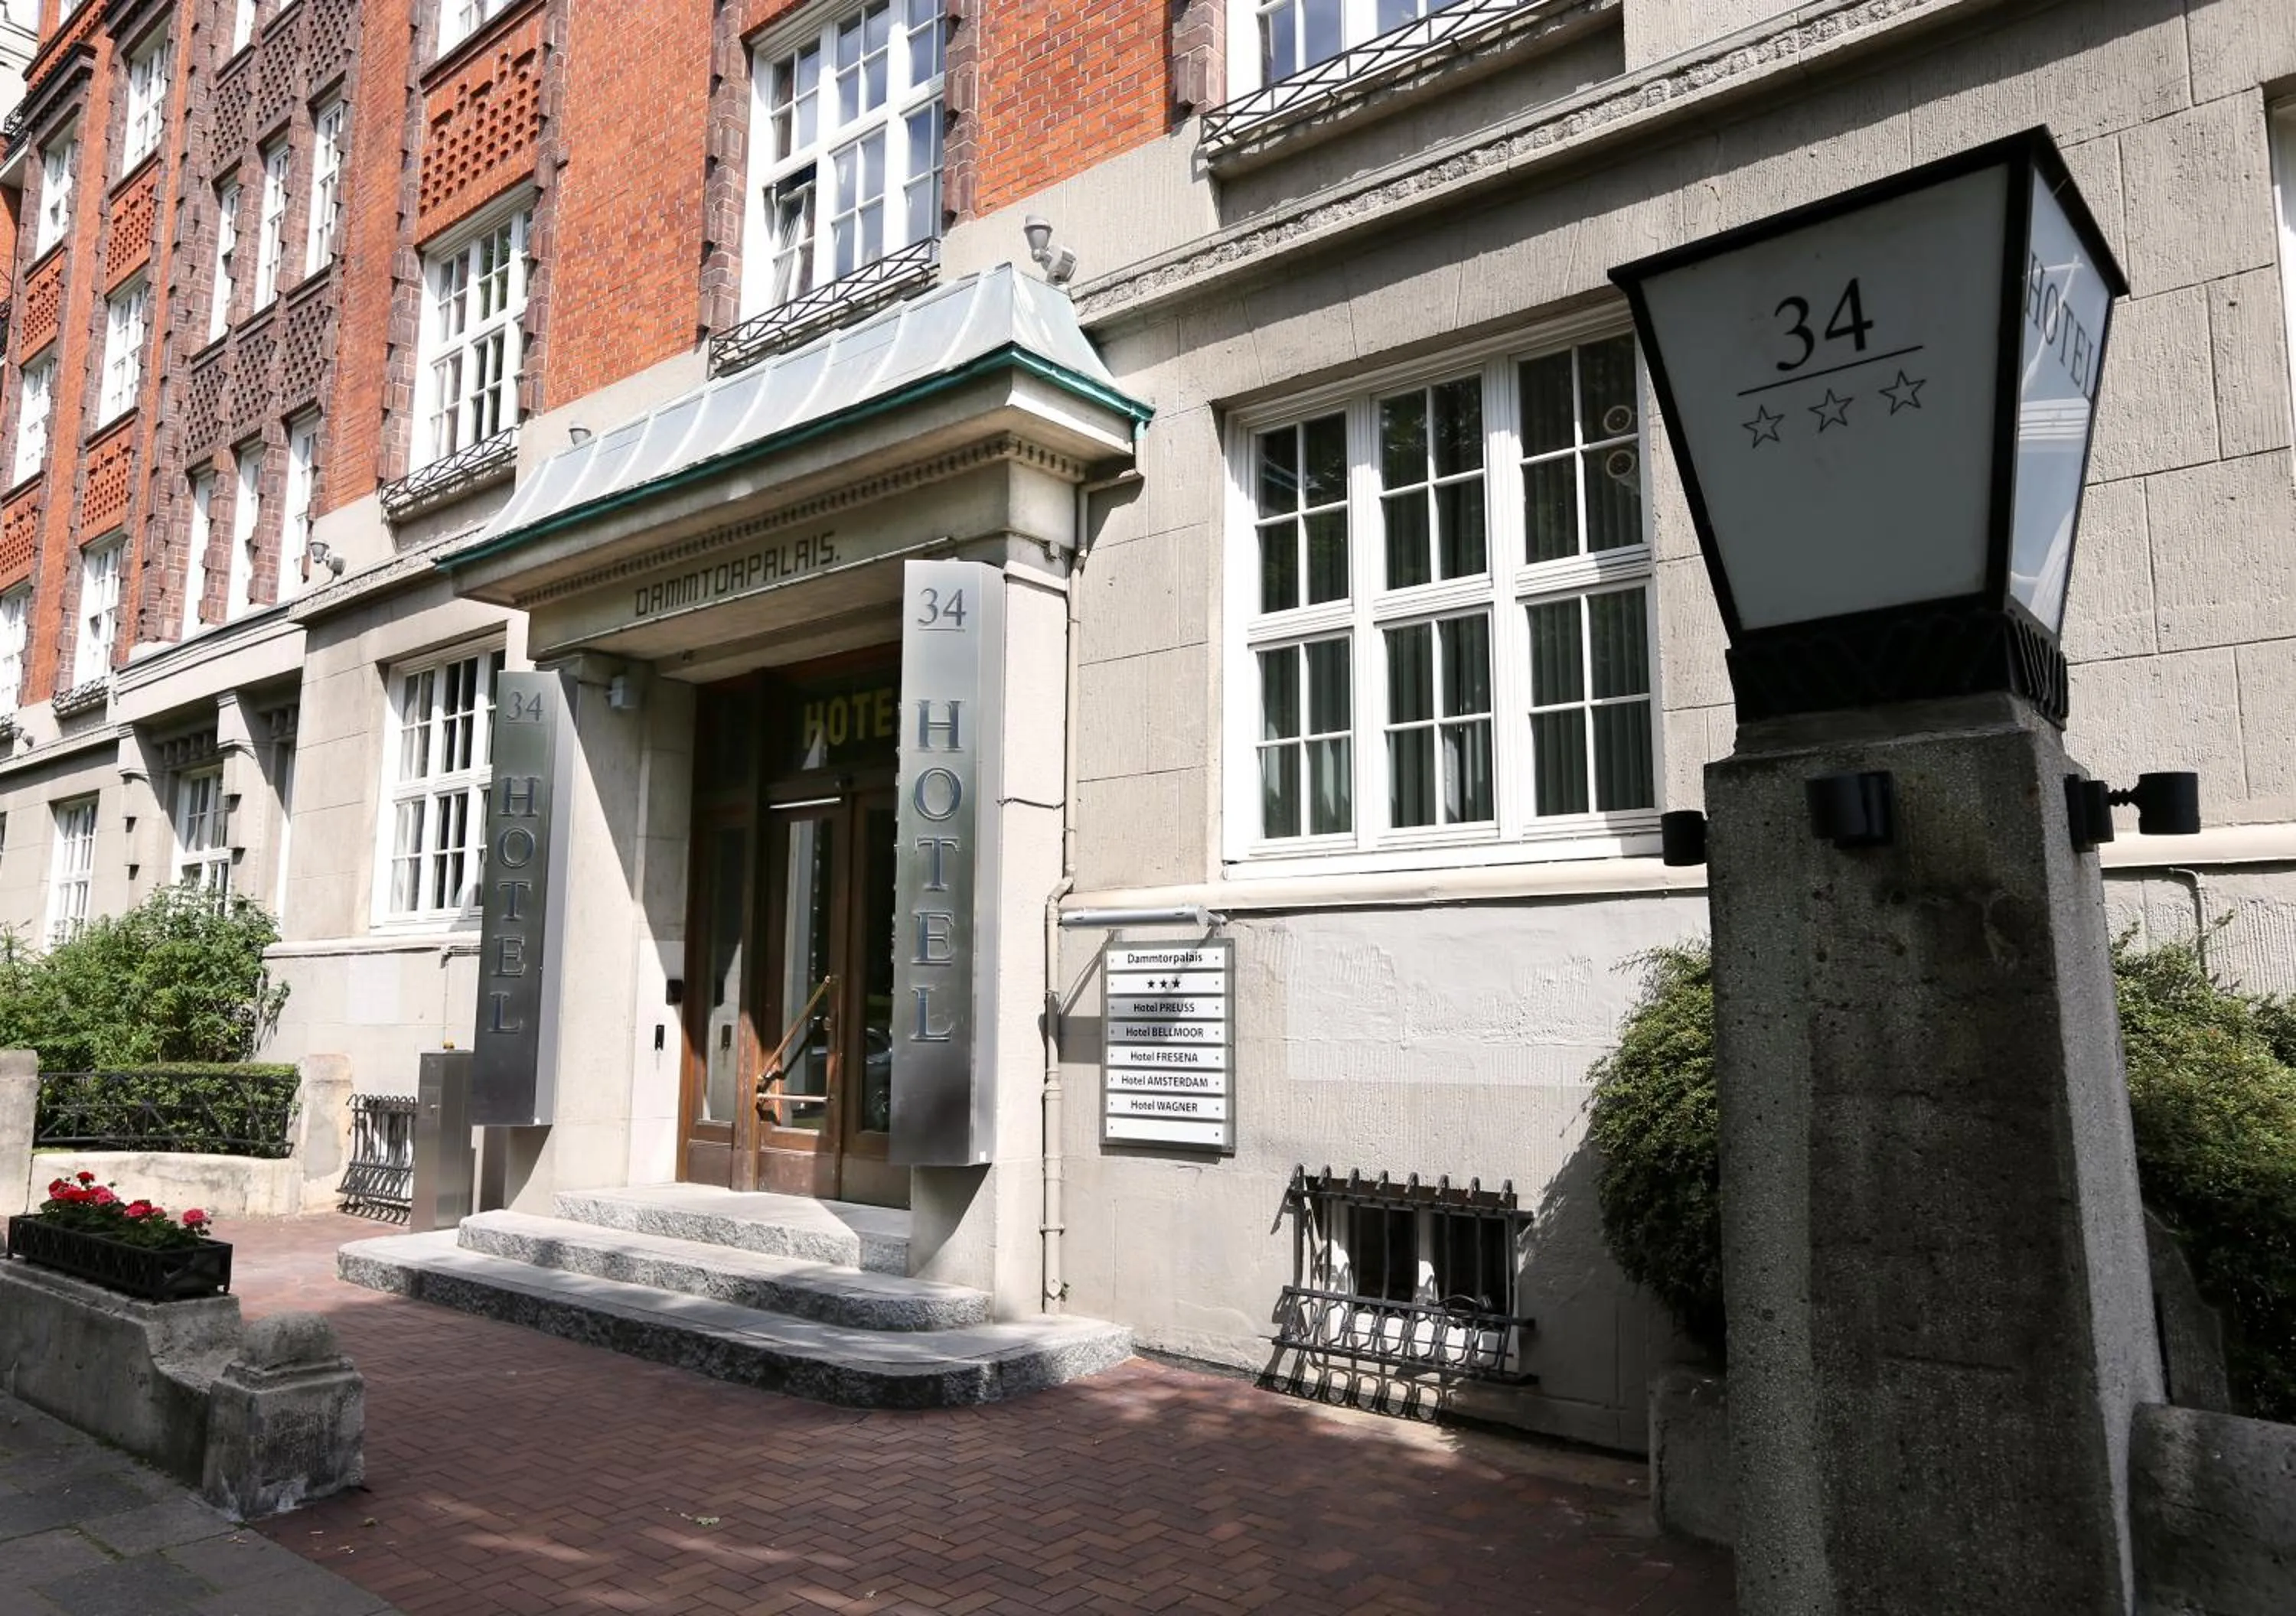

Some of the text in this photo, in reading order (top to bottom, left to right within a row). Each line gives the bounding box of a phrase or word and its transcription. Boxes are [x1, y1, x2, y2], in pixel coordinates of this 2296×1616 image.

[1773, 277, 1874, 371] 34
[2025, 250, 2094, 405] HOTEL
[917, 588, 967, 627] 34
[505, 690, 544, 722] 34
[802, 688, 894, 749] HOTE
[910, 699, 967, 1043] HOTEL
[487, 776, 540, 1034] HOTEL
[1127, 952, 1203, 965] Dammtorpalais
[1133, 1002, 1195, 1012] Hotel PREUSS
[1126, 1027, 1204, 1038] Hotel BELLMOOR
[1130, 1051, 1199, 1063] Hotel FRESENA
[1121, 1075, 1208, 1087] Hotel AMSTERDAM
[1130, 1100, 1198, 1112] Hotel WAGNER
